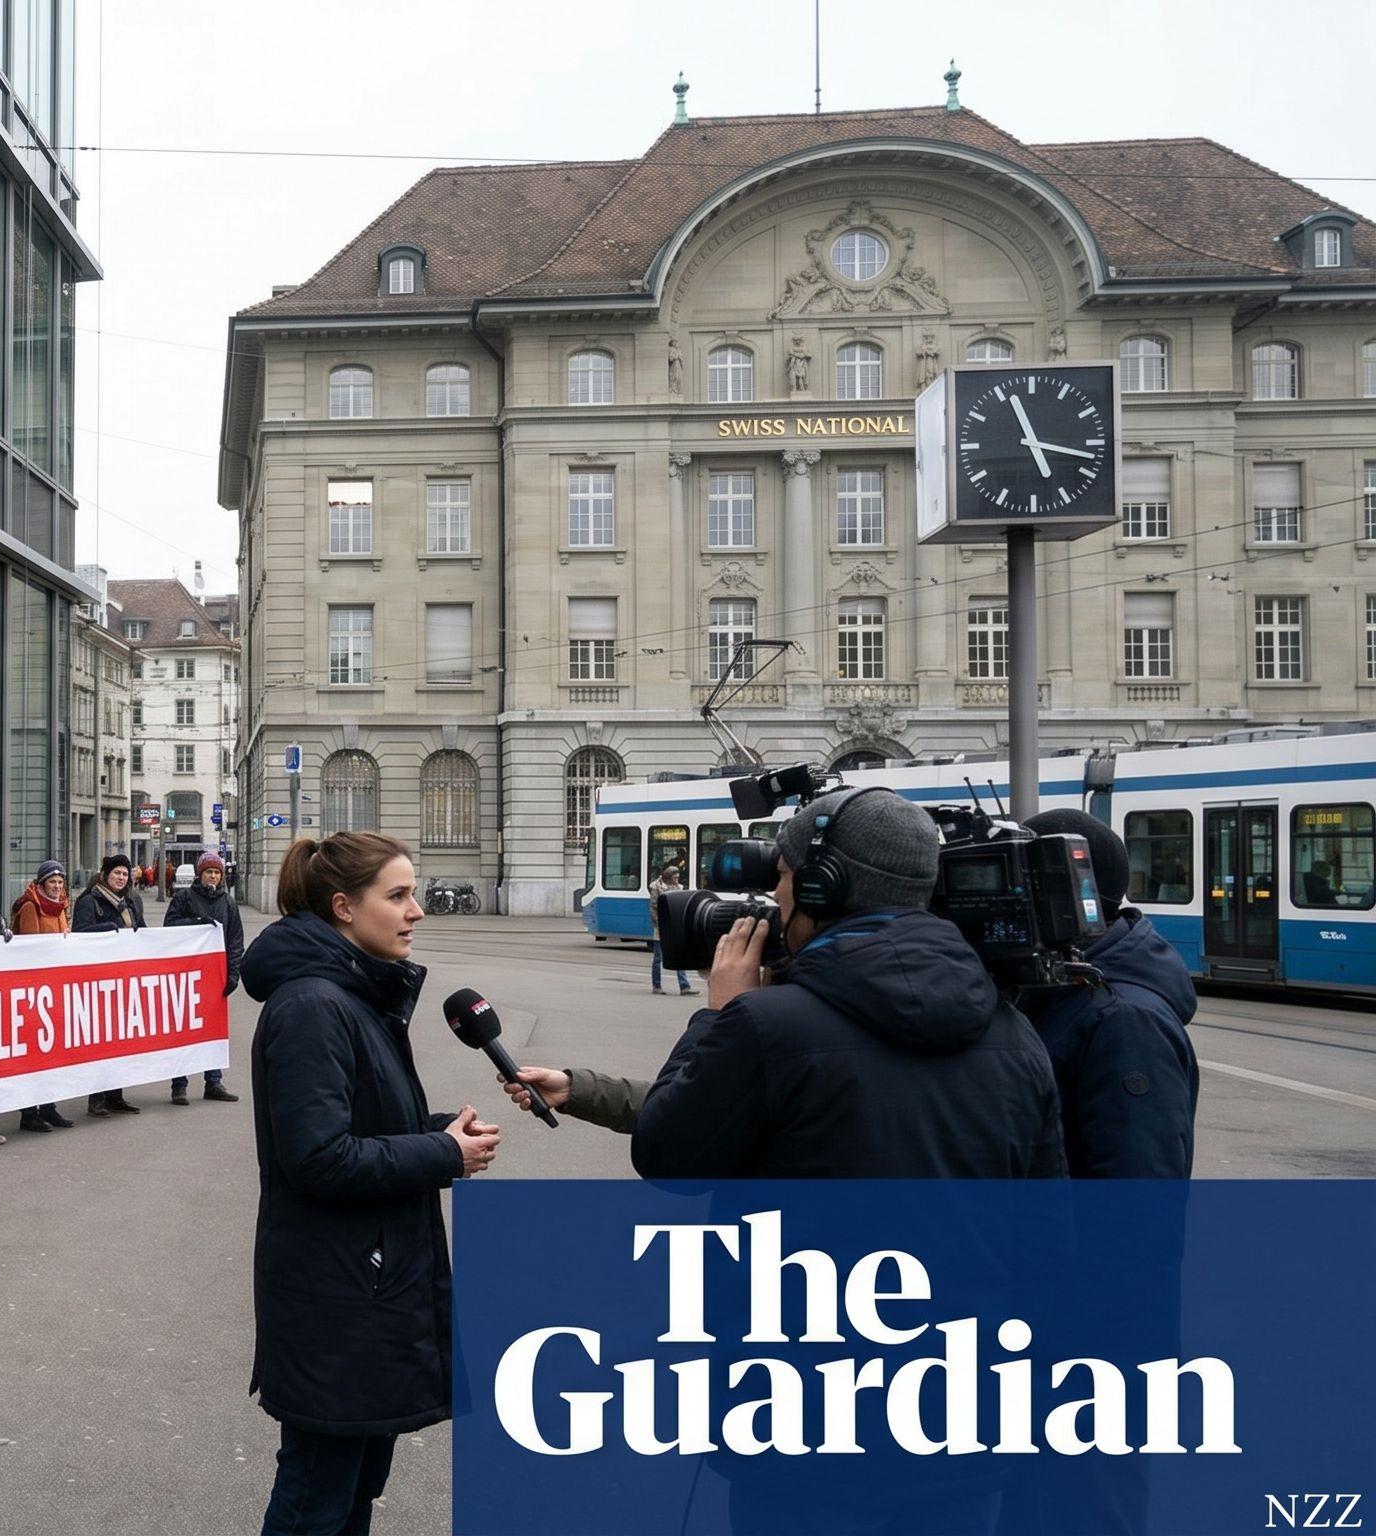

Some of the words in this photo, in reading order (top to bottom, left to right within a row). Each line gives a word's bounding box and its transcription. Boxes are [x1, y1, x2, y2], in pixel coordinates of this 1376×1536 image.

[717, 419, 786, 437] SWISS
[796, 415, 910, 435] NATIONAL
[63, 970, 204, 1049] INITIATIVE
